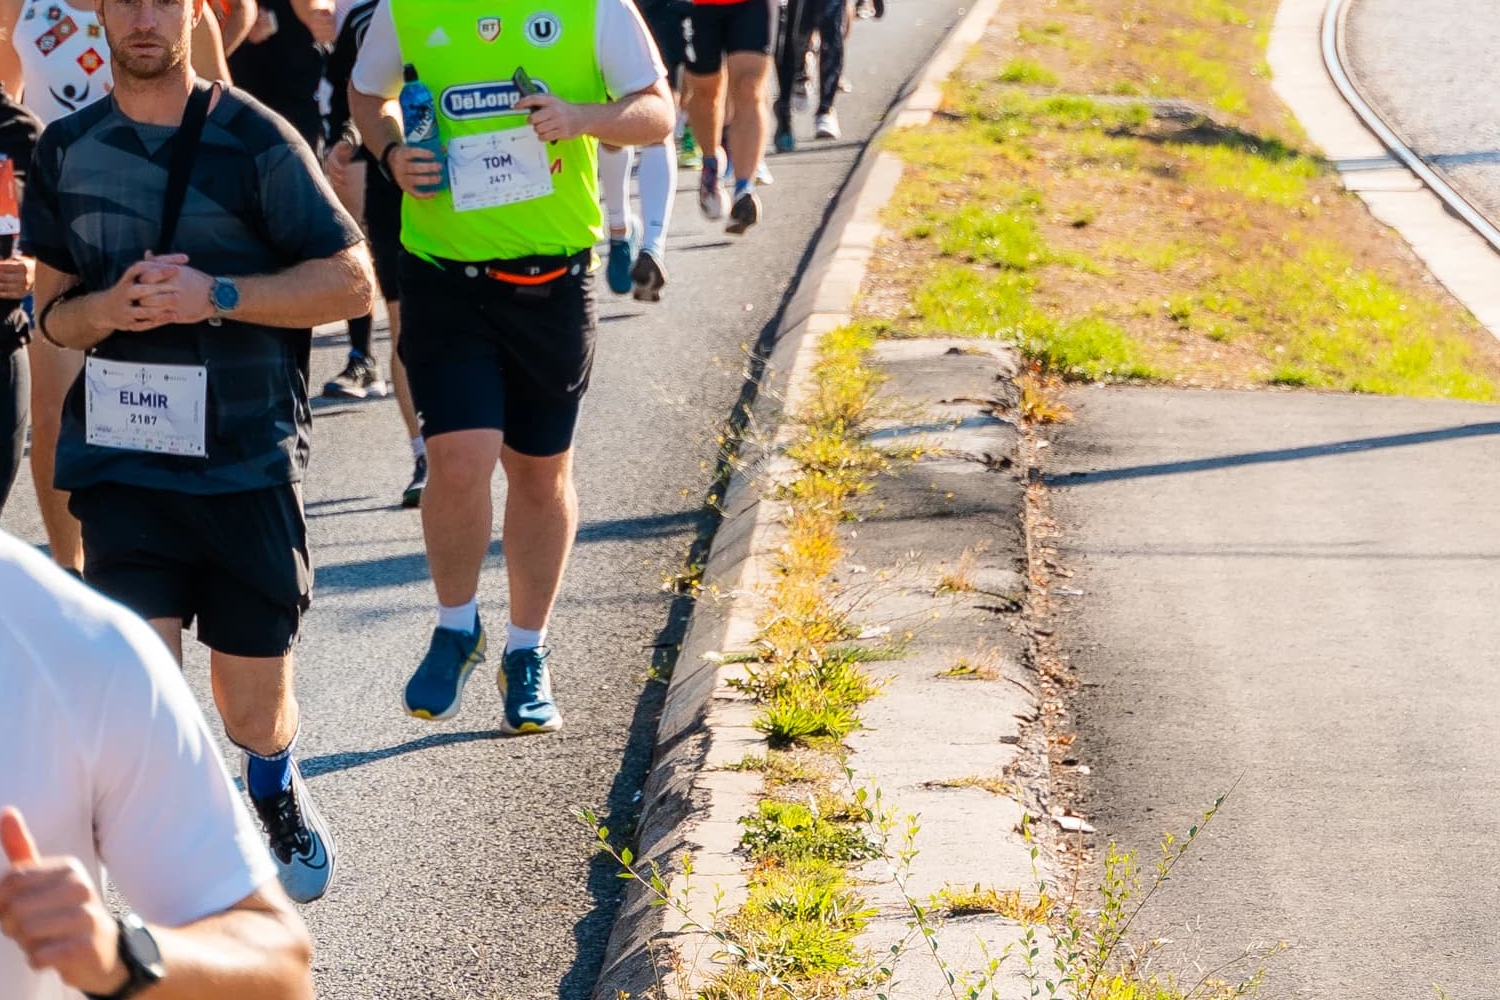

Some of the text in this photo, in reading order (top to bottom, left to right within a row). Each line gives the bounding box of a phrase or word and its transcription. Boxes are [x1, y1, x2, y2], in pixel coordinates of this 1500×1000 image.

[534, 21, 552, 38] U
[483, 154, 512, 169] TOM
[489, 173, 512, 185] 2471
[119, 391, 169, 409] ELMIR
[130, 413, 158, 426] 2187
